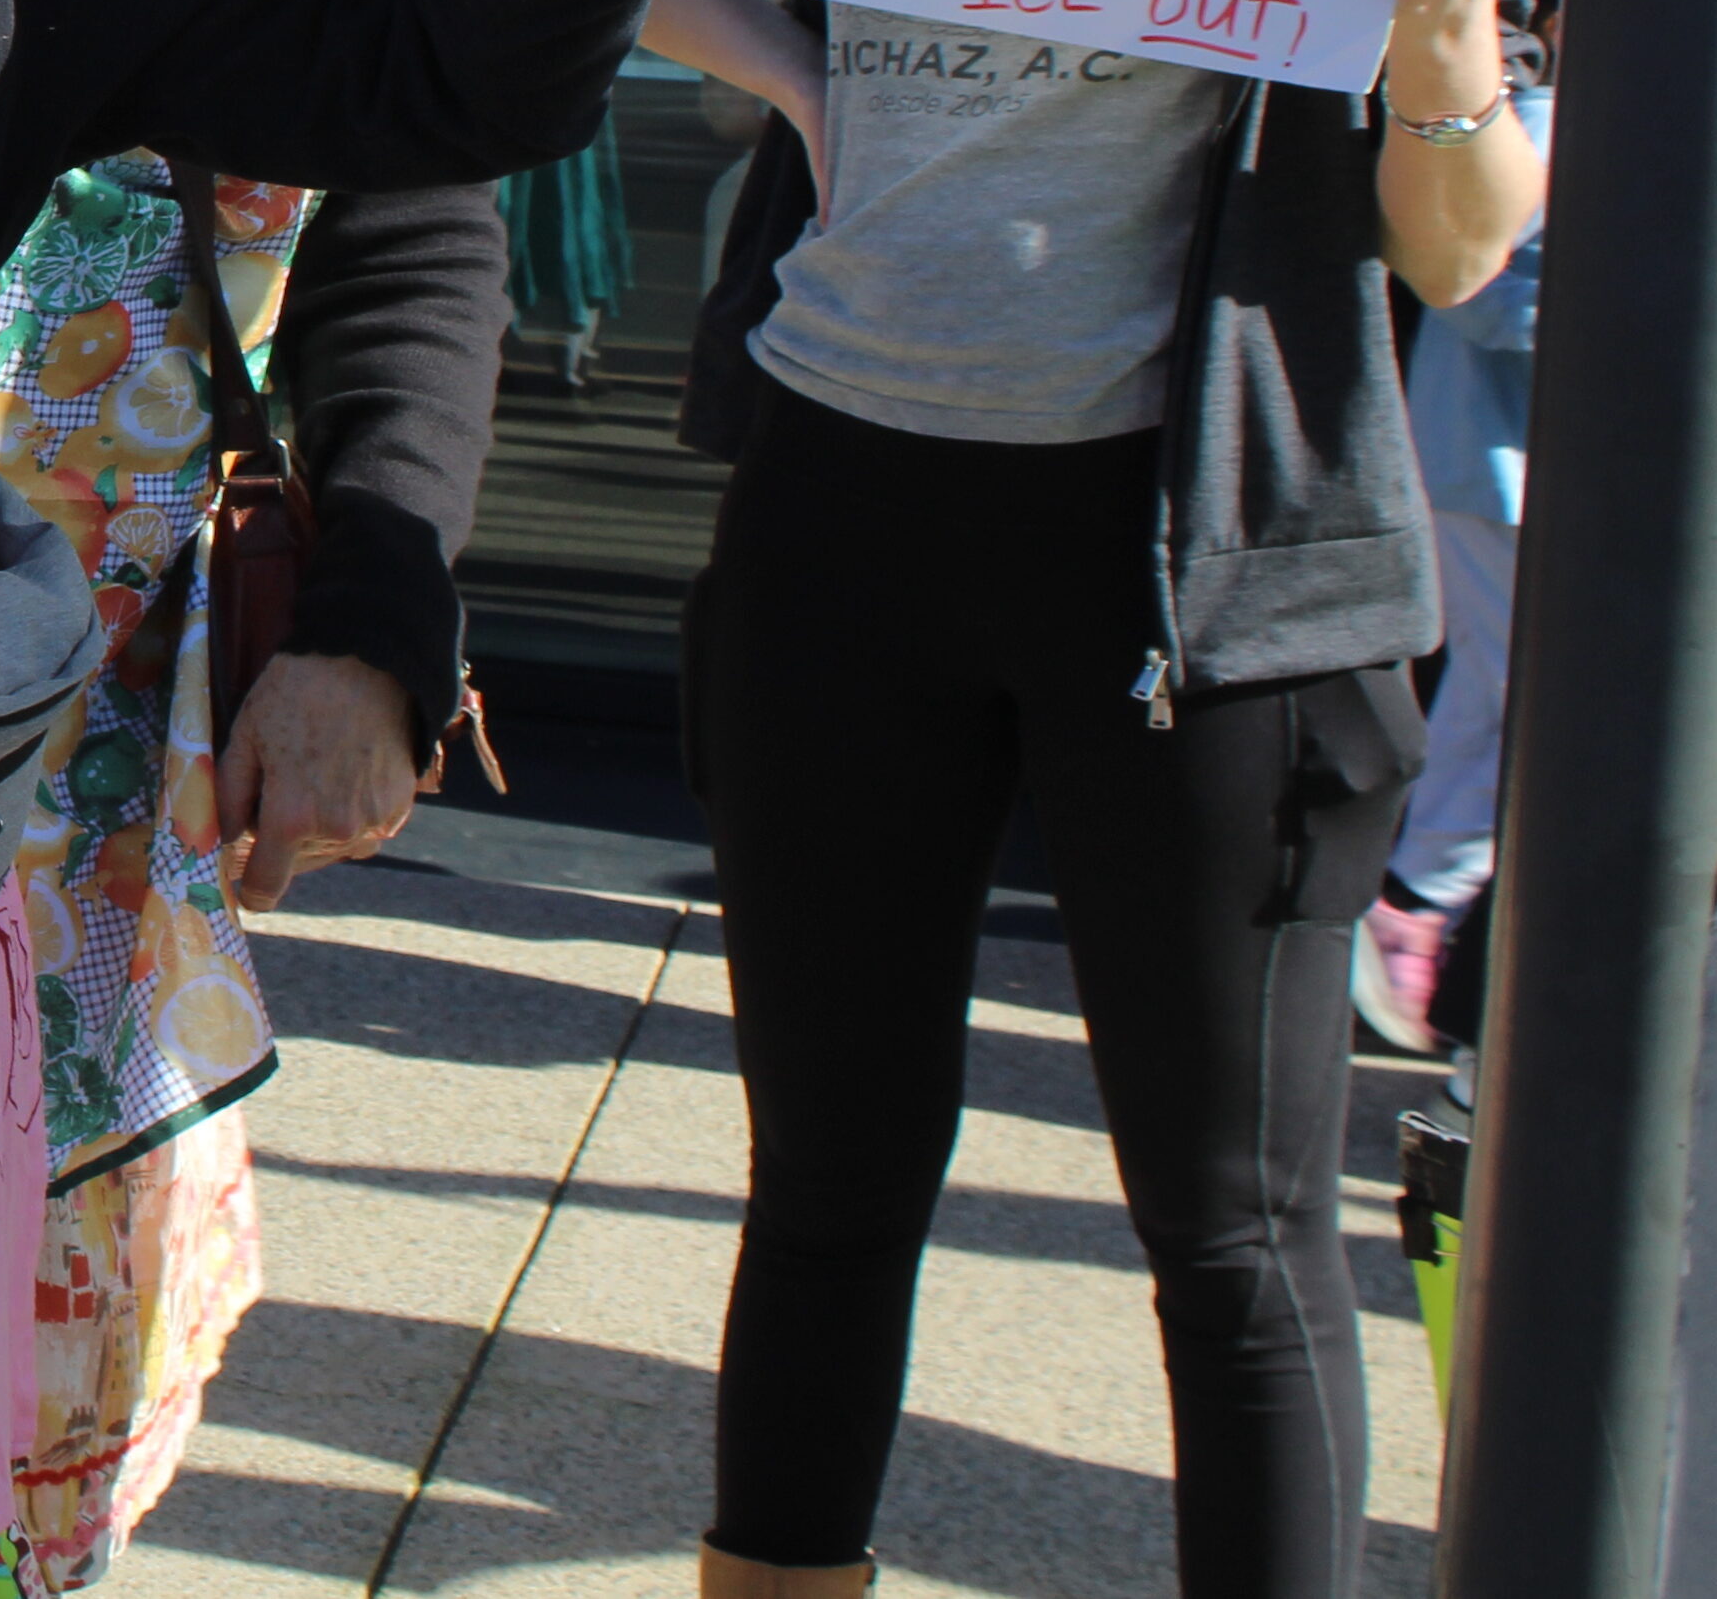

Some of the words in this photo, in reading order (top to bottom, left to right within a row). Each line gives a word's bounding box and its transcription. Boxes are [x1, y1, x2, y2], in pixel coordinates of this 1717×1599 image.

[1018, 46, 1133, 83] A.C.
[870, 91, 943, 114] desde
[948, 91, 1033, 117] 2005
